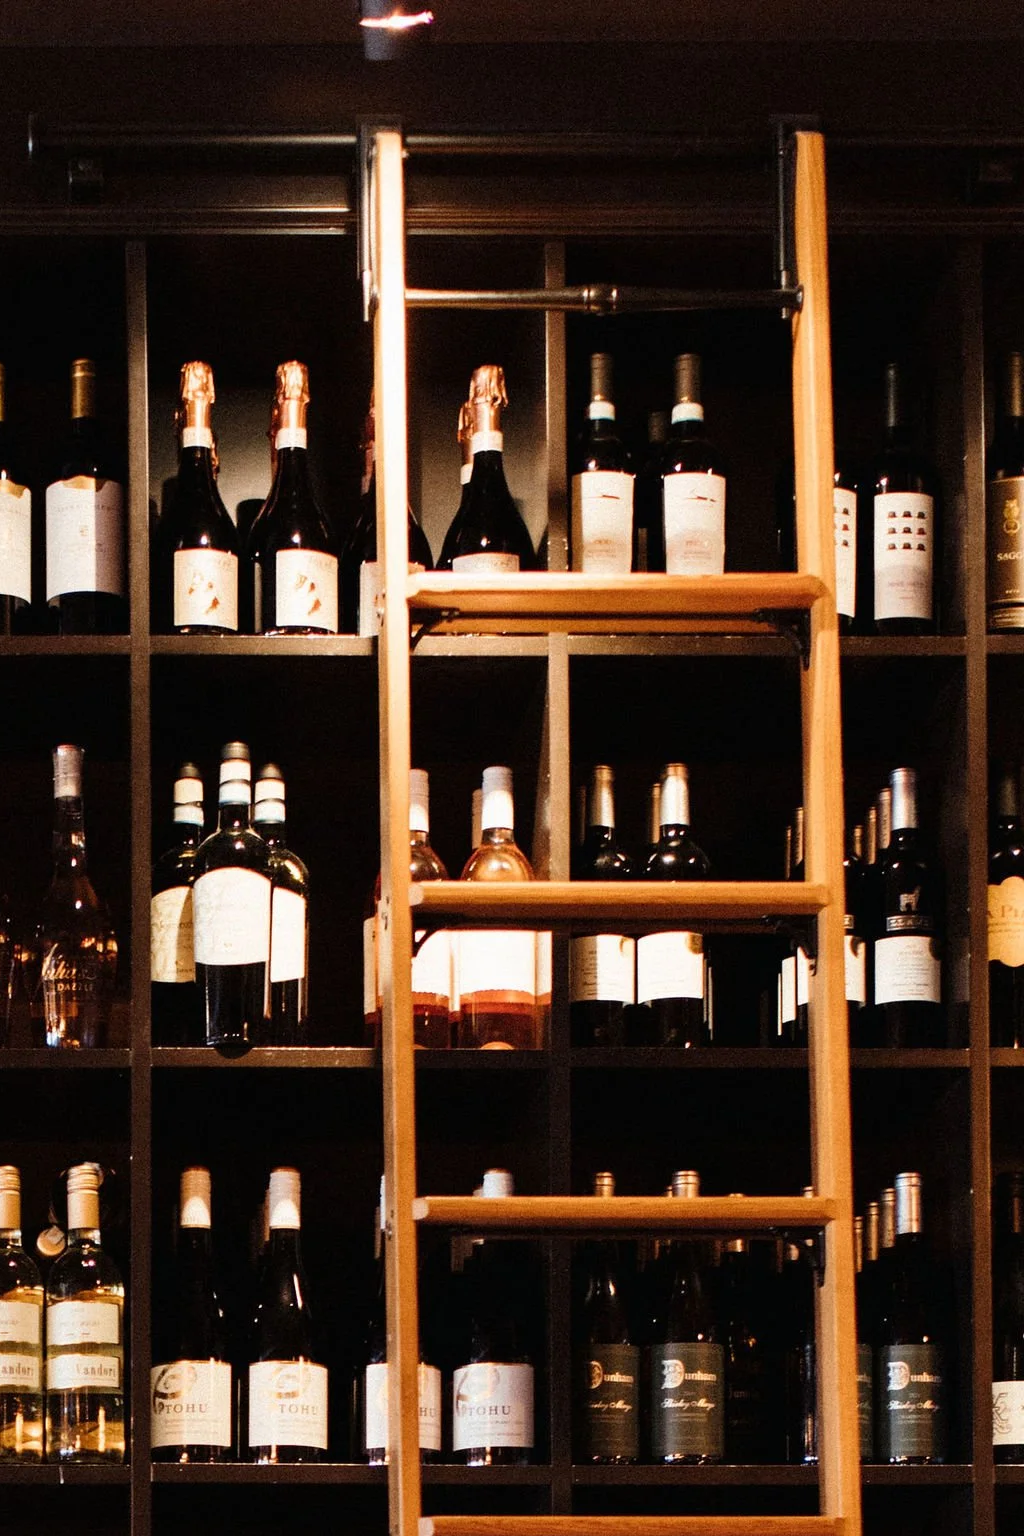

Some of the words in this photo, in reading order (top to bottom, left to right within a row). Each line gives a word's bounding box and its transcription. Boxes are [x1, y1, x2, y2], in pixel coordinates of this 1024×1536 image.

[660, 1359, 717, 1390] Dunham
[887, 1360, 942, 1391] Dunham
[165, 1403, 208, 1414] TOHU
[279, 1403, 320, 1416] TOHU
[468, 1405, 511, 1416] TOHU
